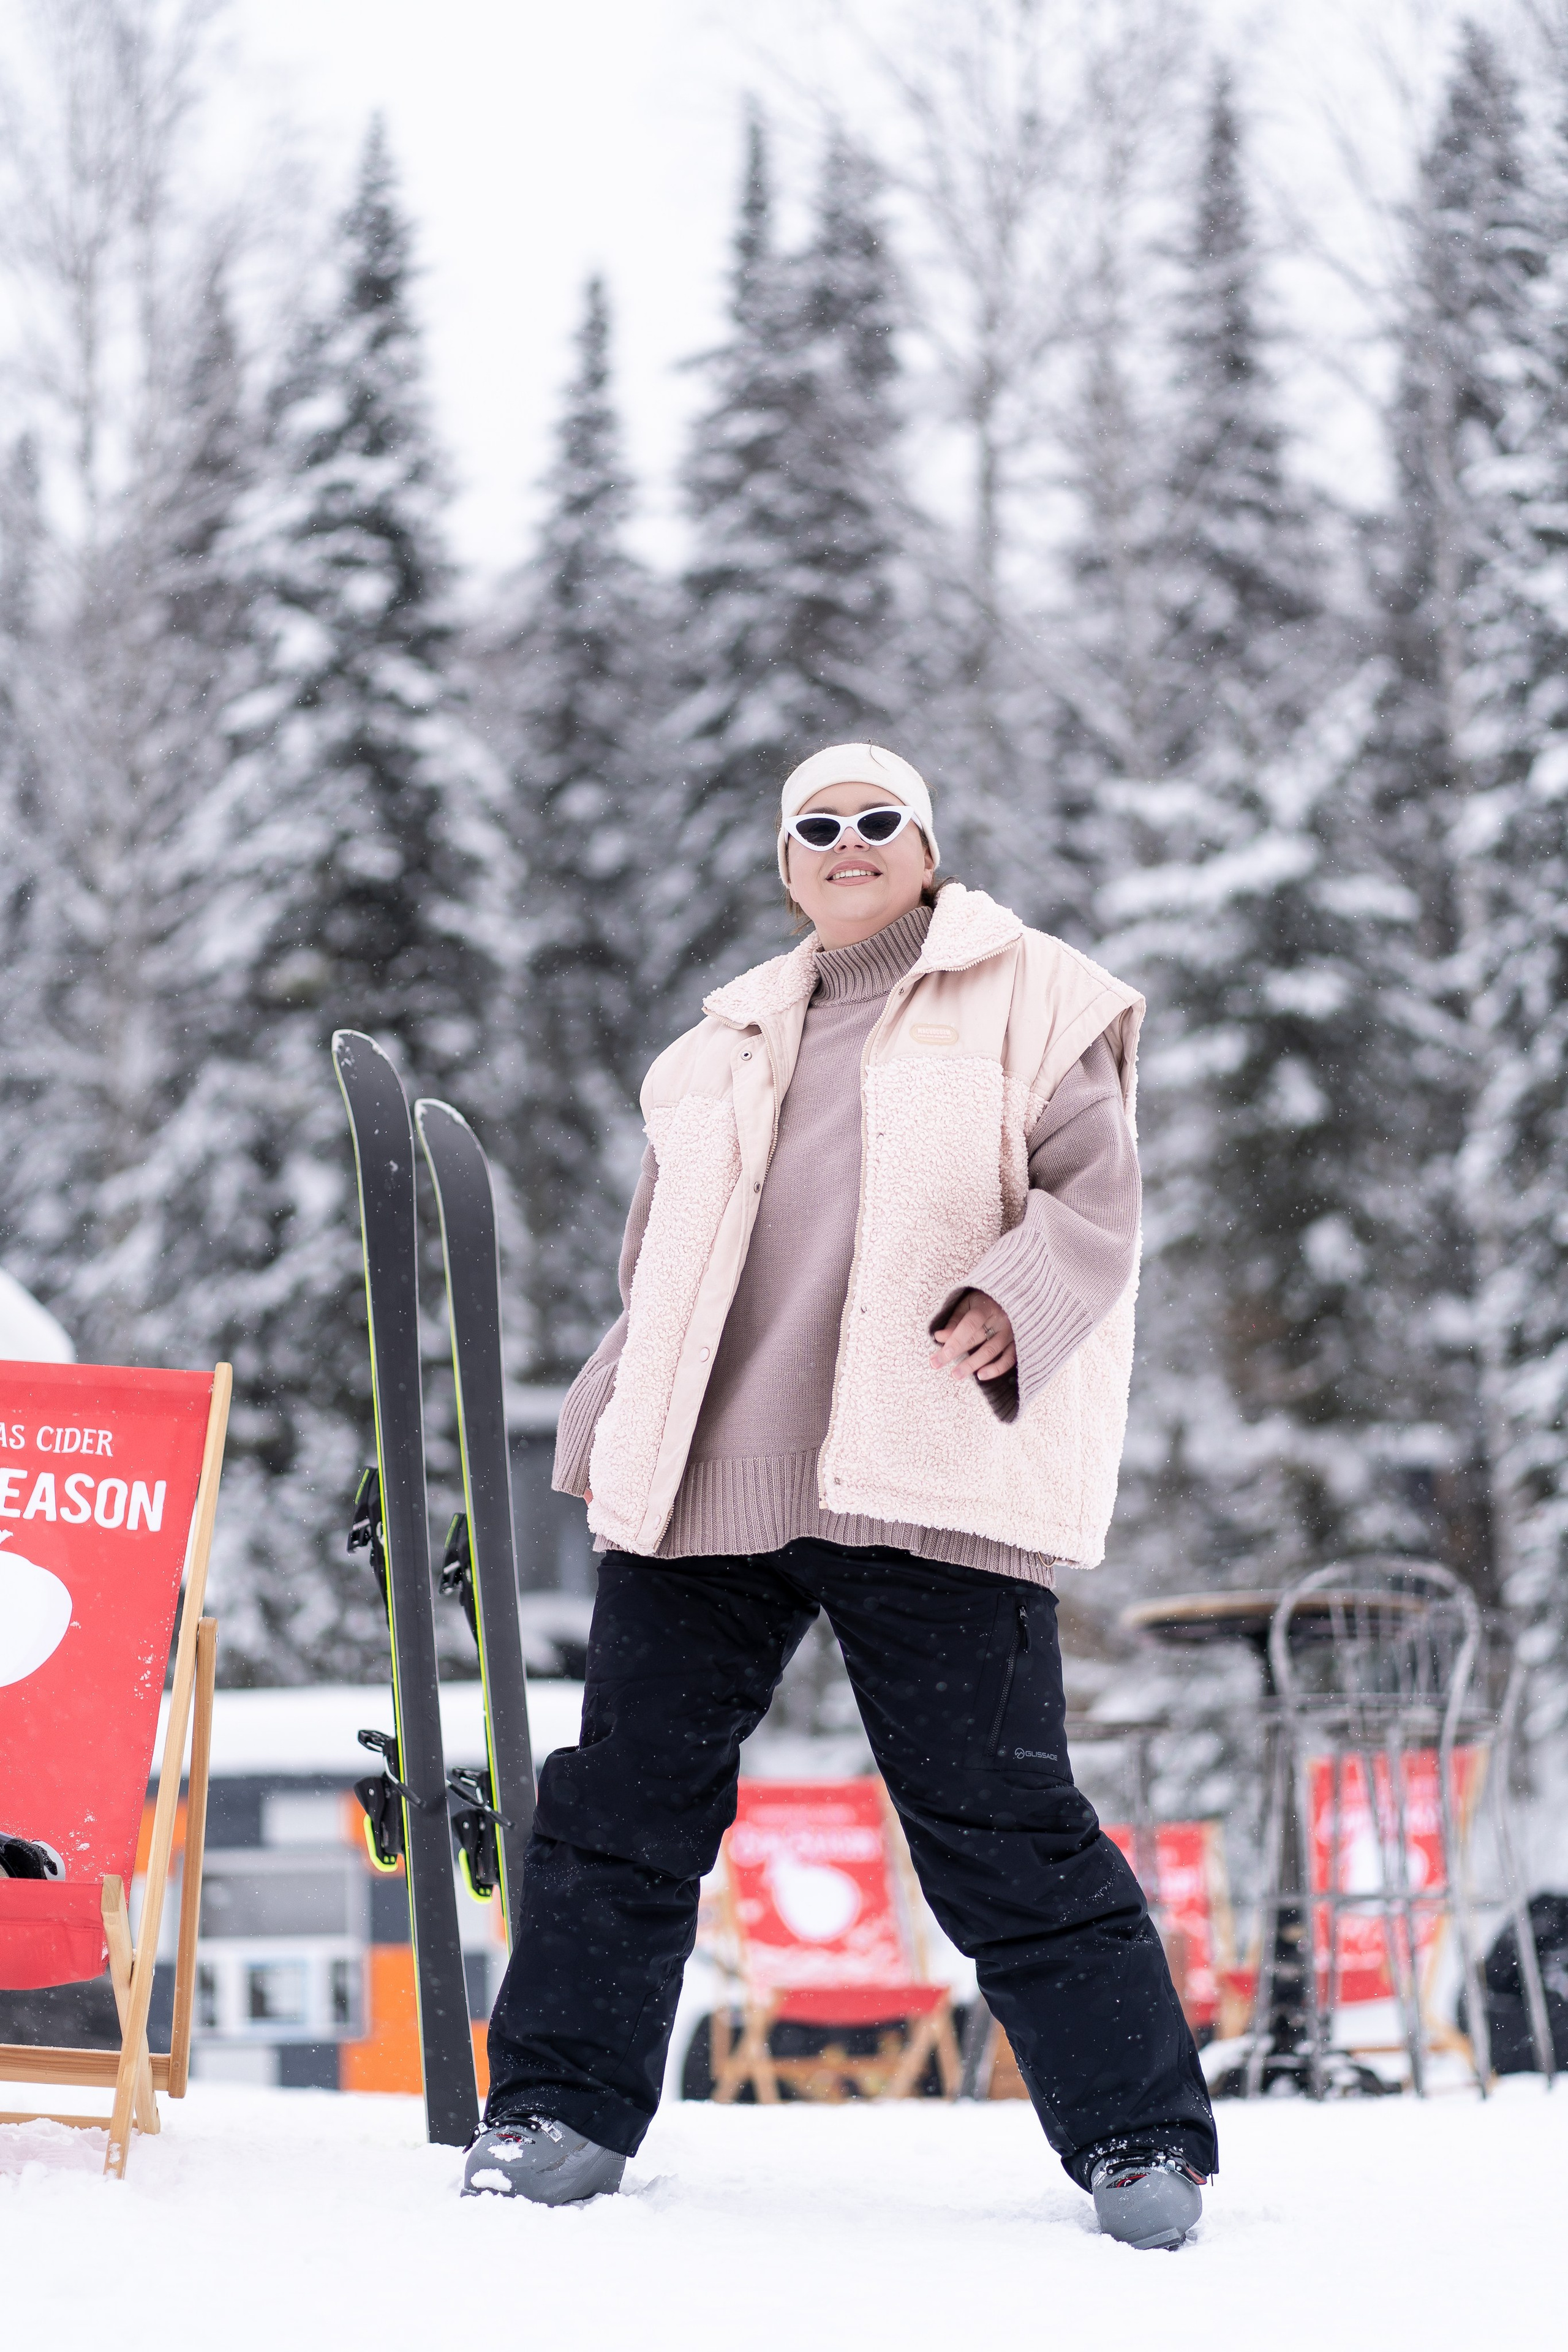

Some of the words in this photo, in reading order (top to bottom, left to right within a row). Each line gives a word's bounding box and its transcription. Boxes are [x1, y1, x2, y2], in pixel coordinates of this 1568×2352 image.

[36, 1425, 114, 1457] CIDER
[0, 1467, 167, 1532] EASON
[1025, 1751, 1058, 1761] GLISSADE
